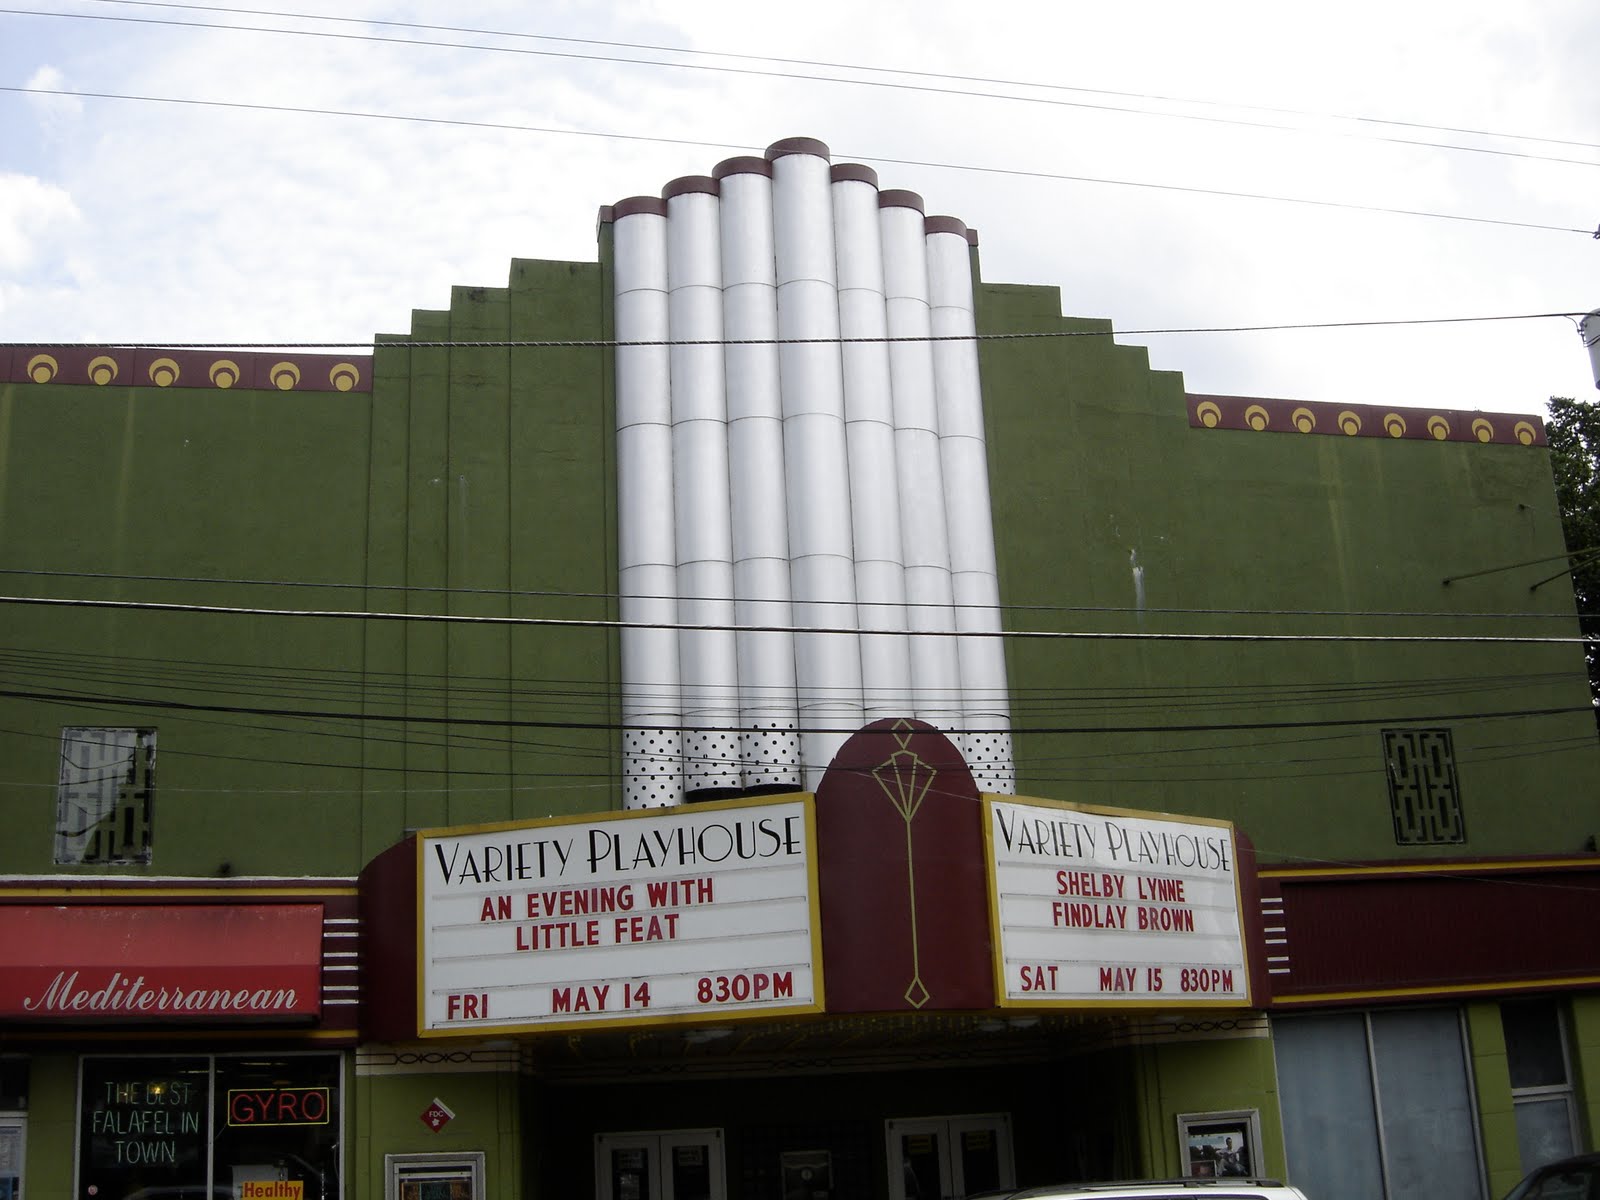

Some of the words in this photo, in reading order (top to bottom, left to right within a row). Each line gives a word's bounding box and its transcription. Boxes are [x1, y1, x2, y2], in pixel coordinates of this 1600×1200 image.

[434, 837, 574, 886] VARIETY
[586, 816, 802, 874] PLAYHOUSE
[996, 808, 1097, 858] VARIETY
[1104, 821, 1231, 872] PLAYHOUSE
[480, 895, 512, 922] AN
[527, 884, 634, 918] EVENING
[646, 877, 714, 908] WITH
[1056, 870, 1125, 899] SHELBY
[1137, 876, 1186, 903] LYNNE
[516, 920, 600, 951] LITTLE
[614, 913, 680, 944] FEAT
[1052, 902, 1127, 930] FINDLAY
[1137, 907, 1195, 933] BROWN
[23, 970, 298, 1011] Mediterranean
[1020, 965, 1059, 992] SAT
[1100, 967, 1137, 992] MAY
[1147, 967, 1163, 992] 15
[1180, 968, 1234, 993] 830PM
[447, 993, 489, 1020] FRI
[551, 984, 610, 1014] MAY
[623, 982, 652, 1008] 14
[696, 971, 794, 1004] 830PM
[104, 1081, 142, 1105] THE
[146, 1080, 192, 1106] BEST
[231, 1091, 325, 1122] GYRO
[92, 1110, 175, 1135] FALAFEL
[181, 1111, 200, 1135] IN
[114, 1141, 176, 1165] TOWN
[244, 1181, 301, 1200] Healthy
